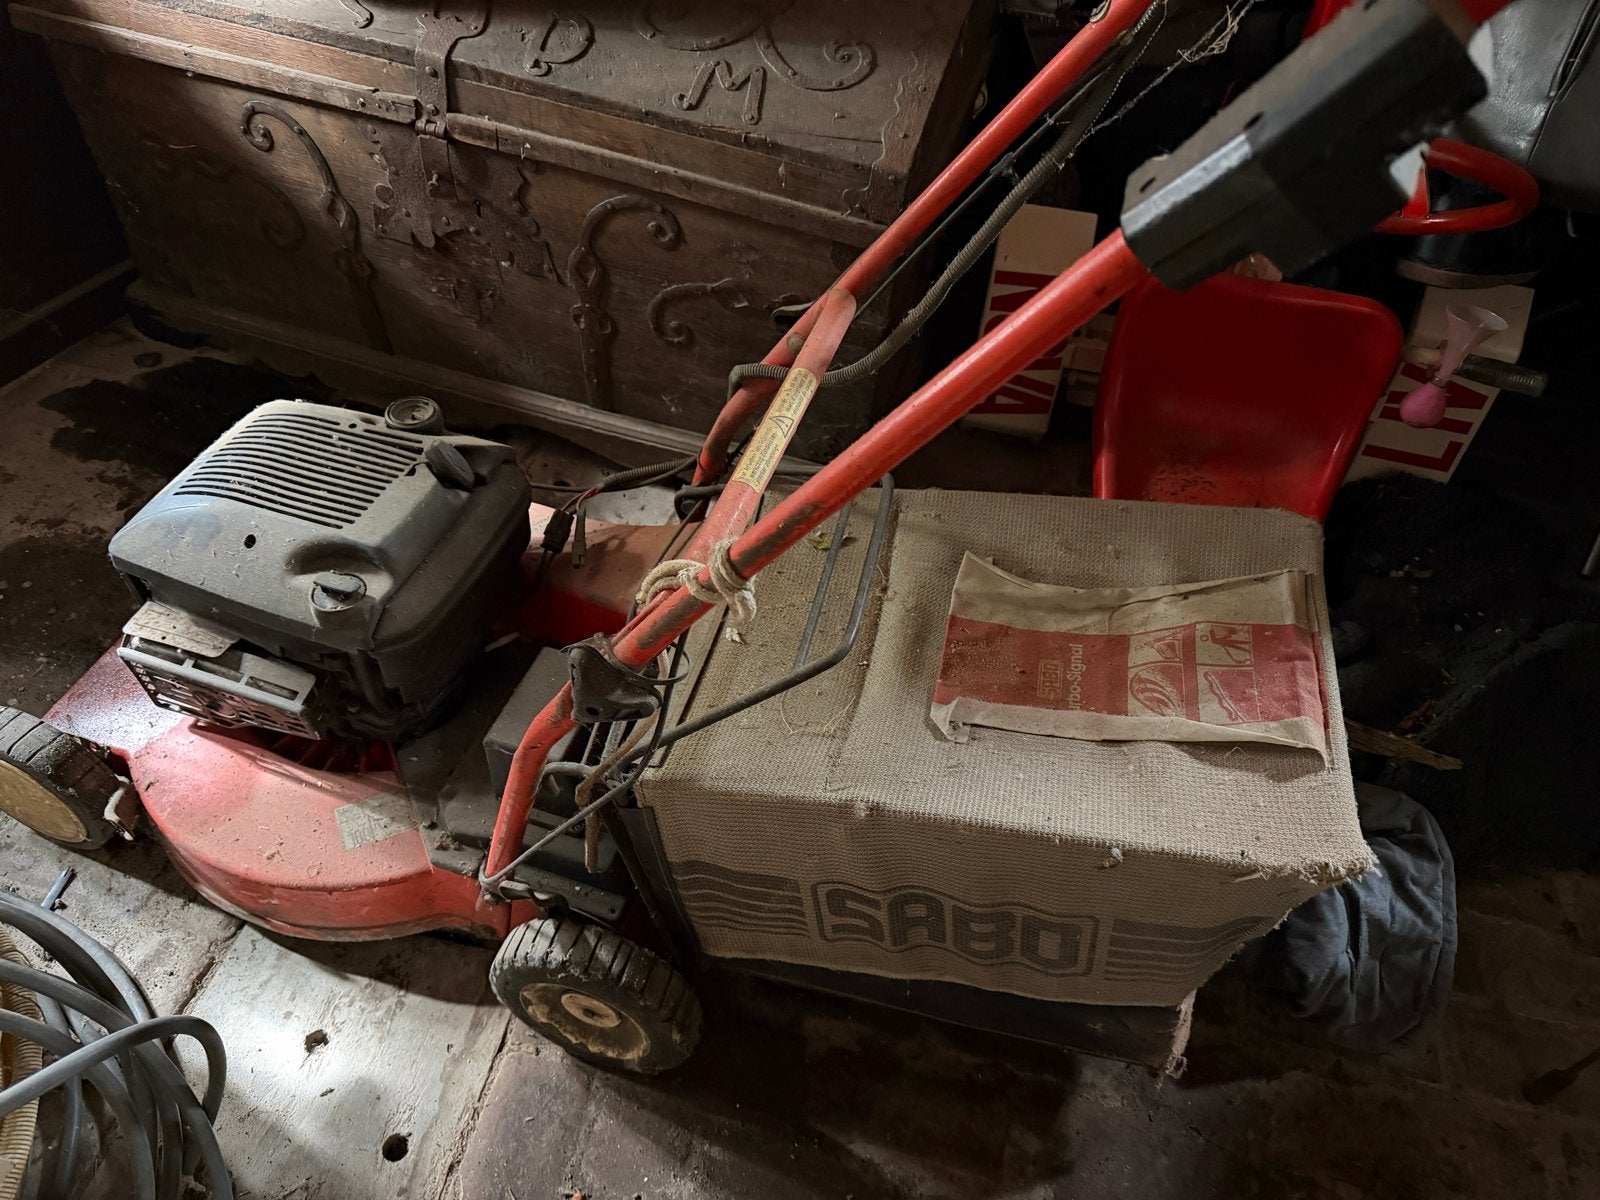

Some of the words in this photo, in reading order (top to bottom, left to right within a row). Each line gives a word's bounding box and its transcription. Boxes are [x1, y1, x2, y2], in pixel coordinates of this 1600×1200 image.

[968, 270, 1072, 414] NVA
[1066, 643, 1087, 711] urbo-Signal
[826, 887, 1081, 970] SABO
